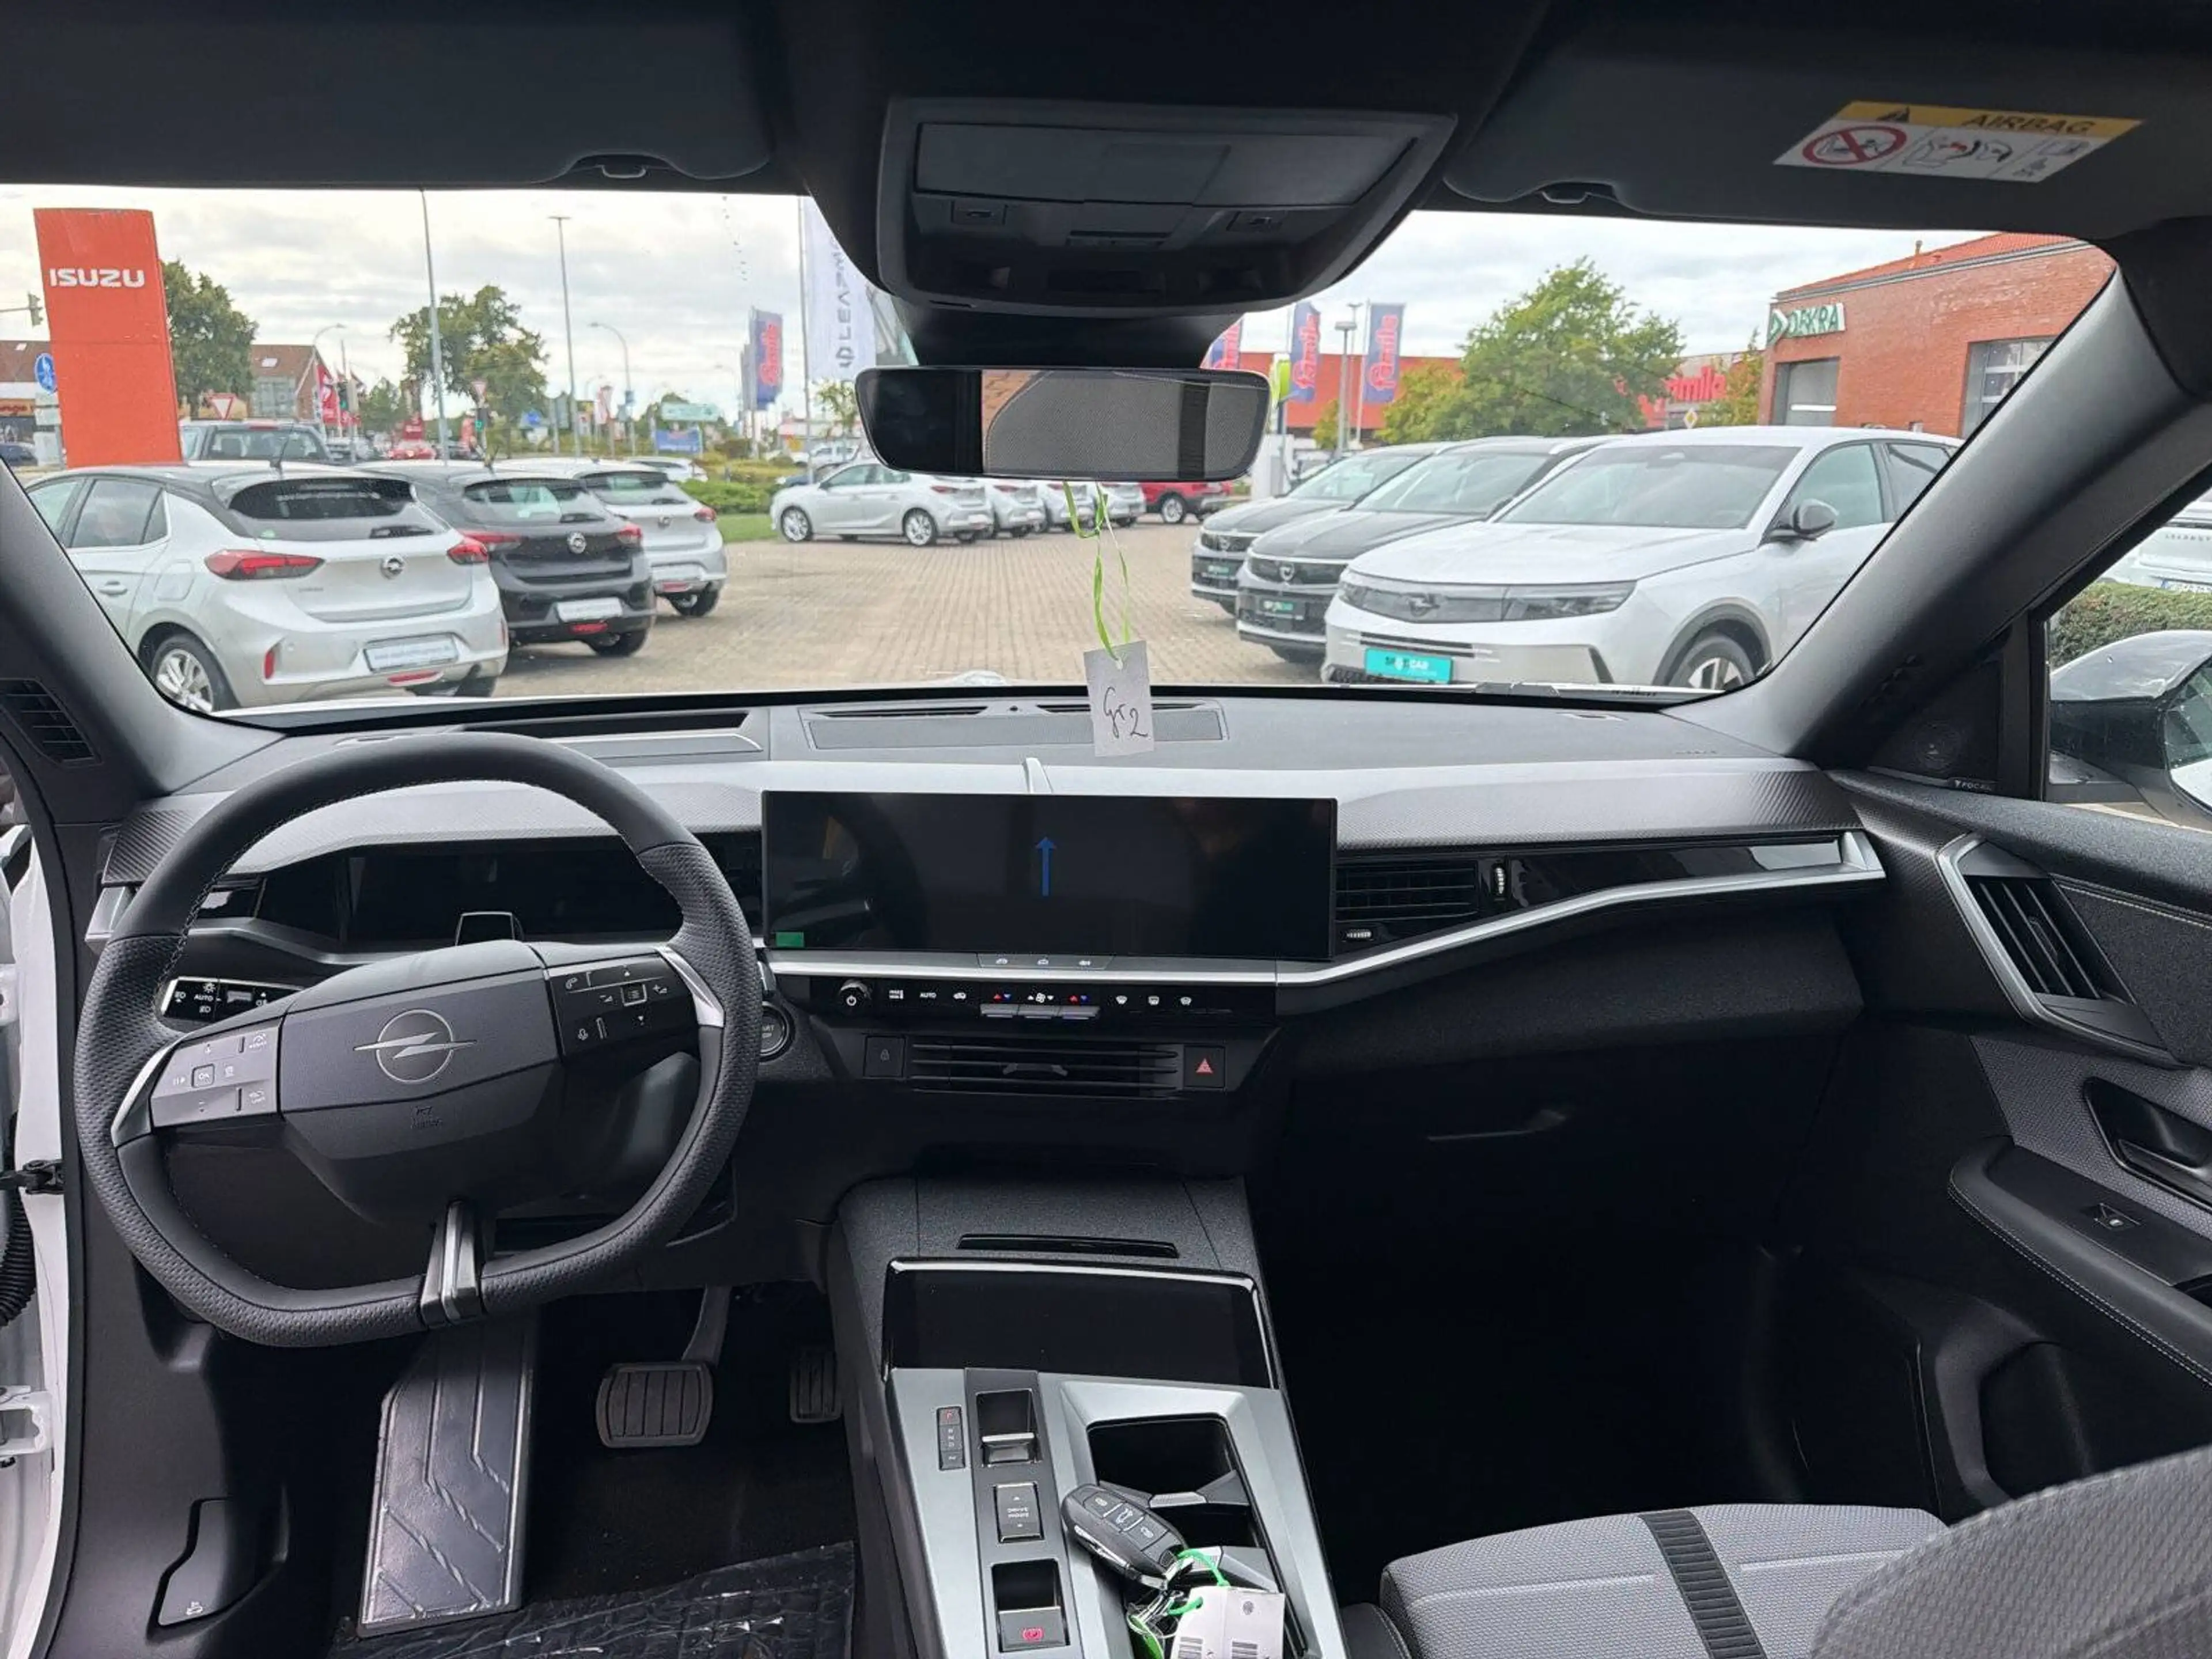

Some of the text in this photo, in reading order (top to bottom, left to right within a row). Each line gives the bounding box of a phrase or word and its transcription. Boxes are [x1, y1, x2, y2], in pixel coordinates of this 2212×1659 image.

[1961, 115, 2096, 134] AIRBAG
[50, 268, 145, 287] ISUZU
[1787, 304, 1839, 336] DEKRA
[194, 994, 214, 1002] AUTO
